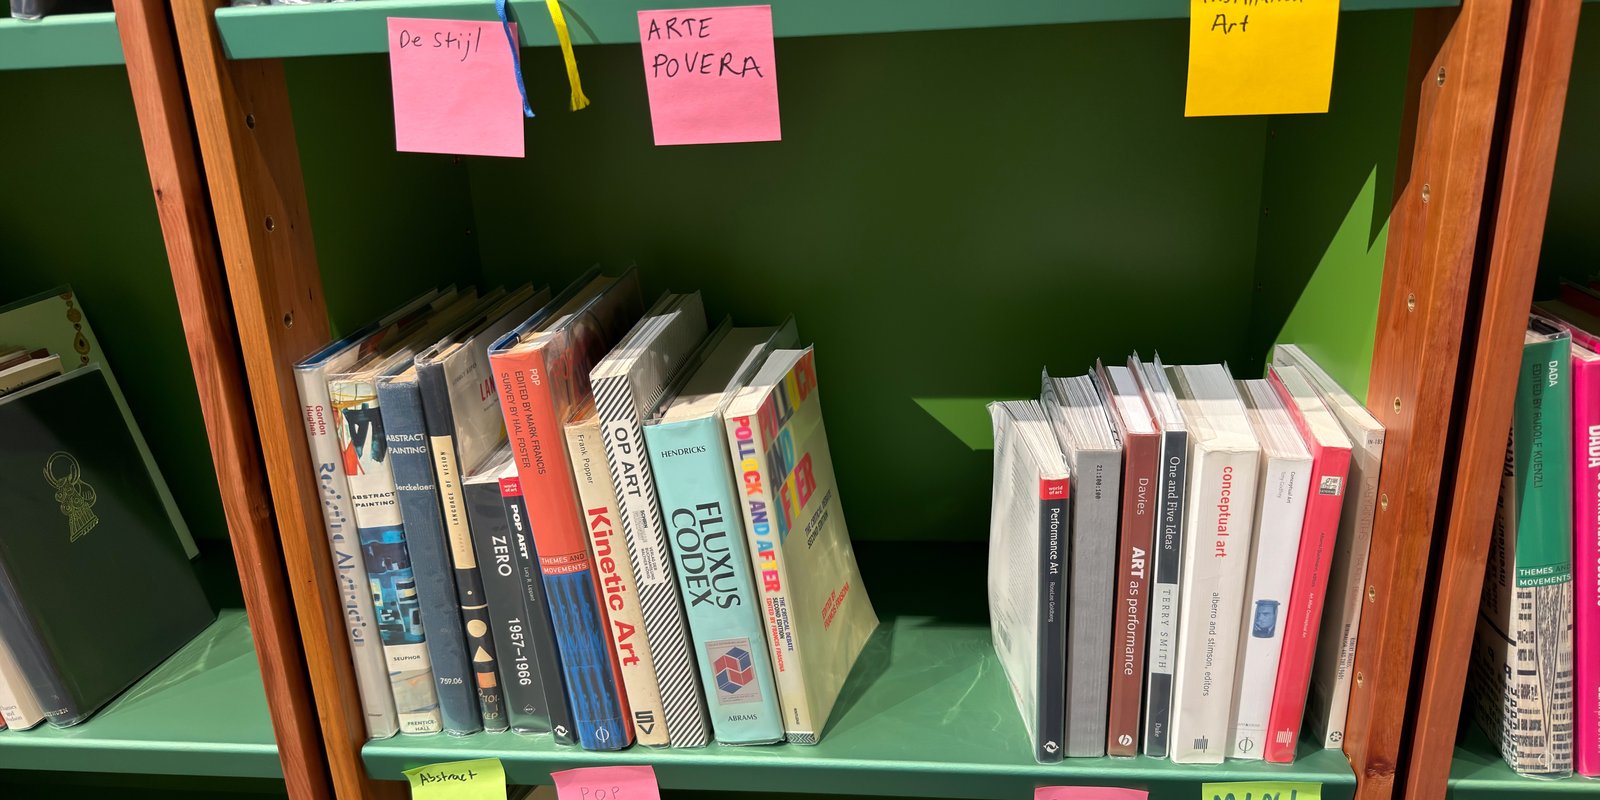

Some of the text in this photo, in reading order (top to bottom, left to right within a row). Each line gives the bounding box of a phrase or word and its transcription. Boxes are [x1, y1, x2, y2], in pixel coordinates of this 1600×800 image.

[647, 17, 713, 41] ARTE
[1211, 14, 1248, 34] Art
[400, 27, 481, 62] De Stijl
[652, 51, 764, 78] POVERA
[529, 368, 540, 386] POP
[1548, 360, 1558, 387] DADA
[305, 405, 317, 437] Hughes
[315, 405, 327, 435] Gordon
[501, 372, 531, 469] SURVEY BY HAL FOSTER
[515, 370, 546, 475] EDITED BY MARK FRANCIS
[1532, 363, 1543, 488] EDITED BY RUDOLF KUENZLI
[386, 434, 424, 442] ABSTRACT
[388, 446, 426, 455] PAINTING
[614, 426, 631, 455] OP
[661, 445, 706, 459] HENDRICKS
[577, 434, 593, 484] Frank Popper
[352, 491, 395, 500] ABSTRACT
[441, 451, 459, 526] LANGUAGE OF VISION
[621, 461, 642, 497] ART
[733, 416, 782, 593] POLLOCK AND AFTER
[1136, 478, 1148, 515] Davies
[1165, 456, 1180, 550] One and Five Ideas
[1215, 466, 1233, 558] conceptual art
[510, 504, 529, 560] POP ART
[1049, 507, 1060, 575] Performance Art
[491, 535, 512, 577] ZERO
[541, 553, 585, 564] THEMES AND
[543, 563, 587, 573] MOVEMENTS
[671, 508, 714, 607] CODEX
[696, 501, 741, 609] FLUXUS
[1519, 564, 1571, 576] THEMES AND
[588, 506, 640, 667] Kinetic Art
[1519, 574, 1571, 586] MOVEMENTS
[766, 597, 774, 615] EDITED
[772, 625, 780, 647] FRANCIS
[772, 597, 785, 639] SECOND EDITION
[781, 608, 790, 630] CRITICAL
[1123, 546, 1146, 676] ART as performance
[785, 632, 794, 651] DEBATE
[1158, 589, 1171, 669] TERRY SMITH
[1202, 592, 1221, 697] alberro and stimson, editors
[440, 677, 463, 685] 759.06
[728, 713, 758, 722] ABRAMS
[1154, 722, 1162, 738] Duke
[420, 770, 478, 786] Abstract
